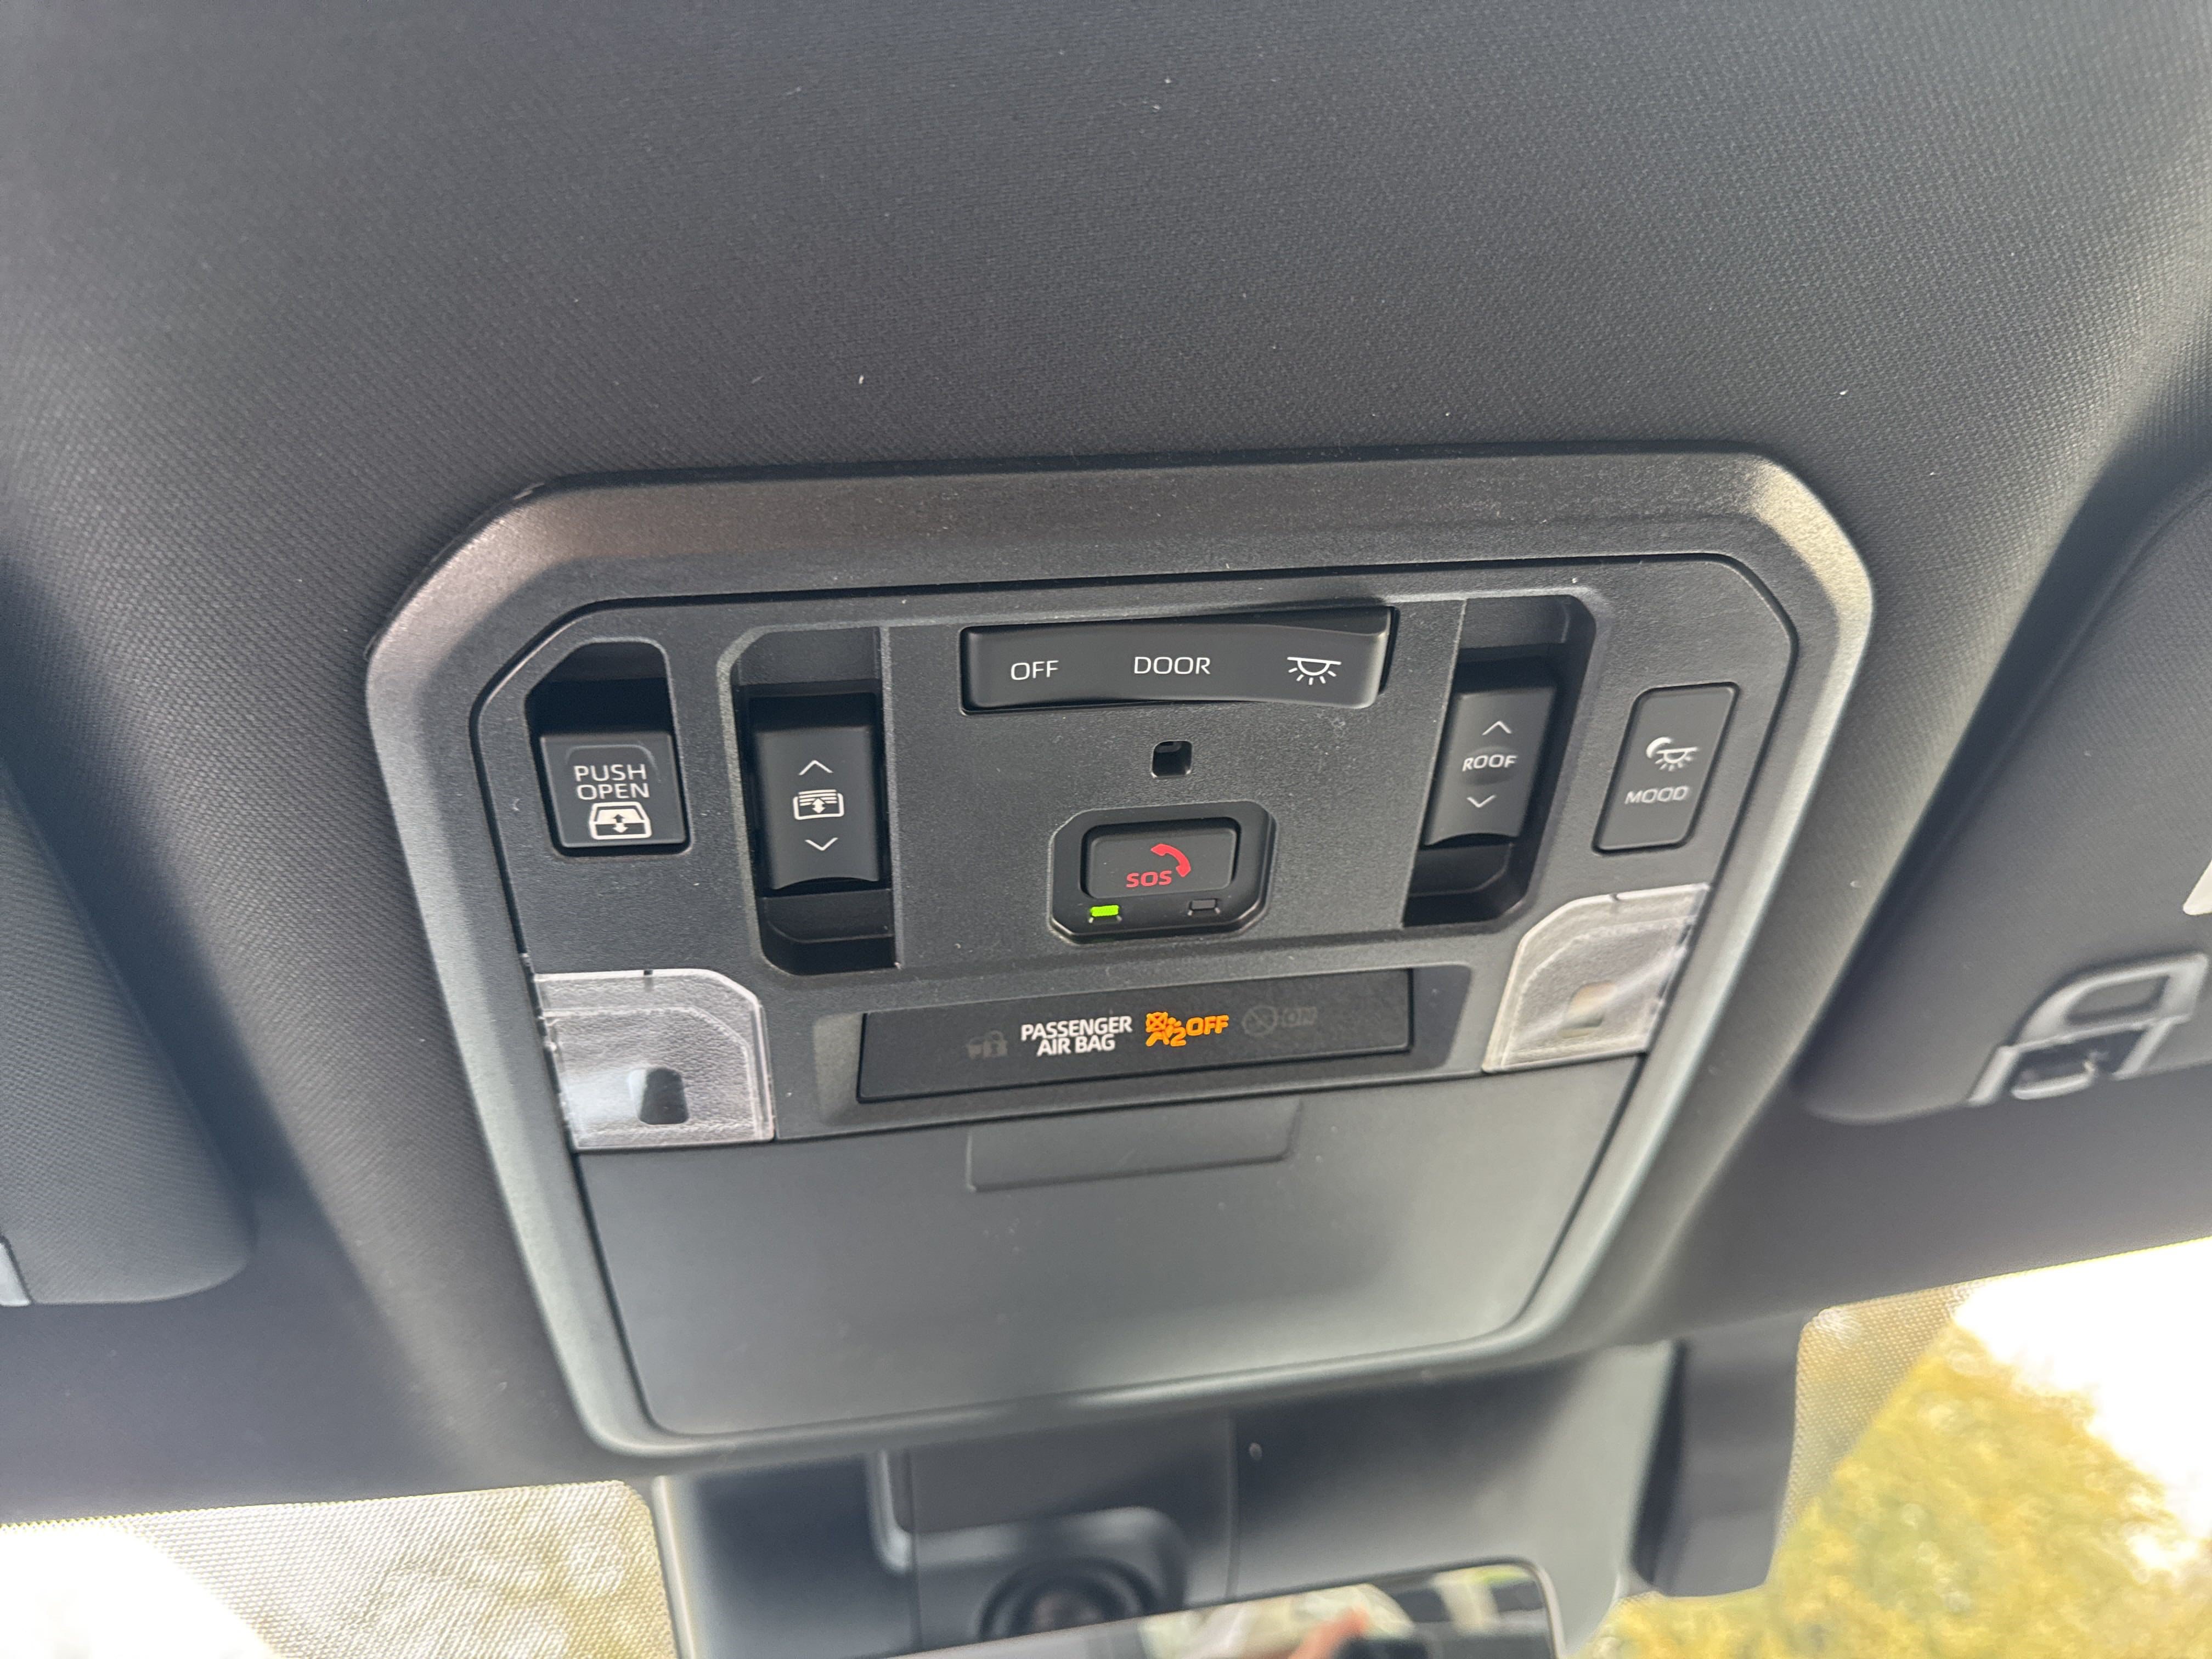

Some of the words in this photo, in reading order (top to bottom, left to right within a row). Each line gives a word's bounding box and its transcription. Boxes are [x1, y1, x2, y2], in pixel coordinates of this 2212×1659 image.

[1011, 660, 1059, 680] OFF
[1133, 656, 1211, 674] DOOR
[1462, 754, 1517, 771] ROOF
[574, 764, 647, 782] PUSH
[577, 783, 650, 800] OPEN
[1625, 786, 1689, 804] MOOD
[1126, 870, 1172, 888] SOS
[1021, 1015, 1133, 1041] PASSENGER
[1186, 1015, 1229, 1036] OFF
[1036, 1039, 1071, 1057] AIR
[1075, 1034, 1116, 1053] BAG
